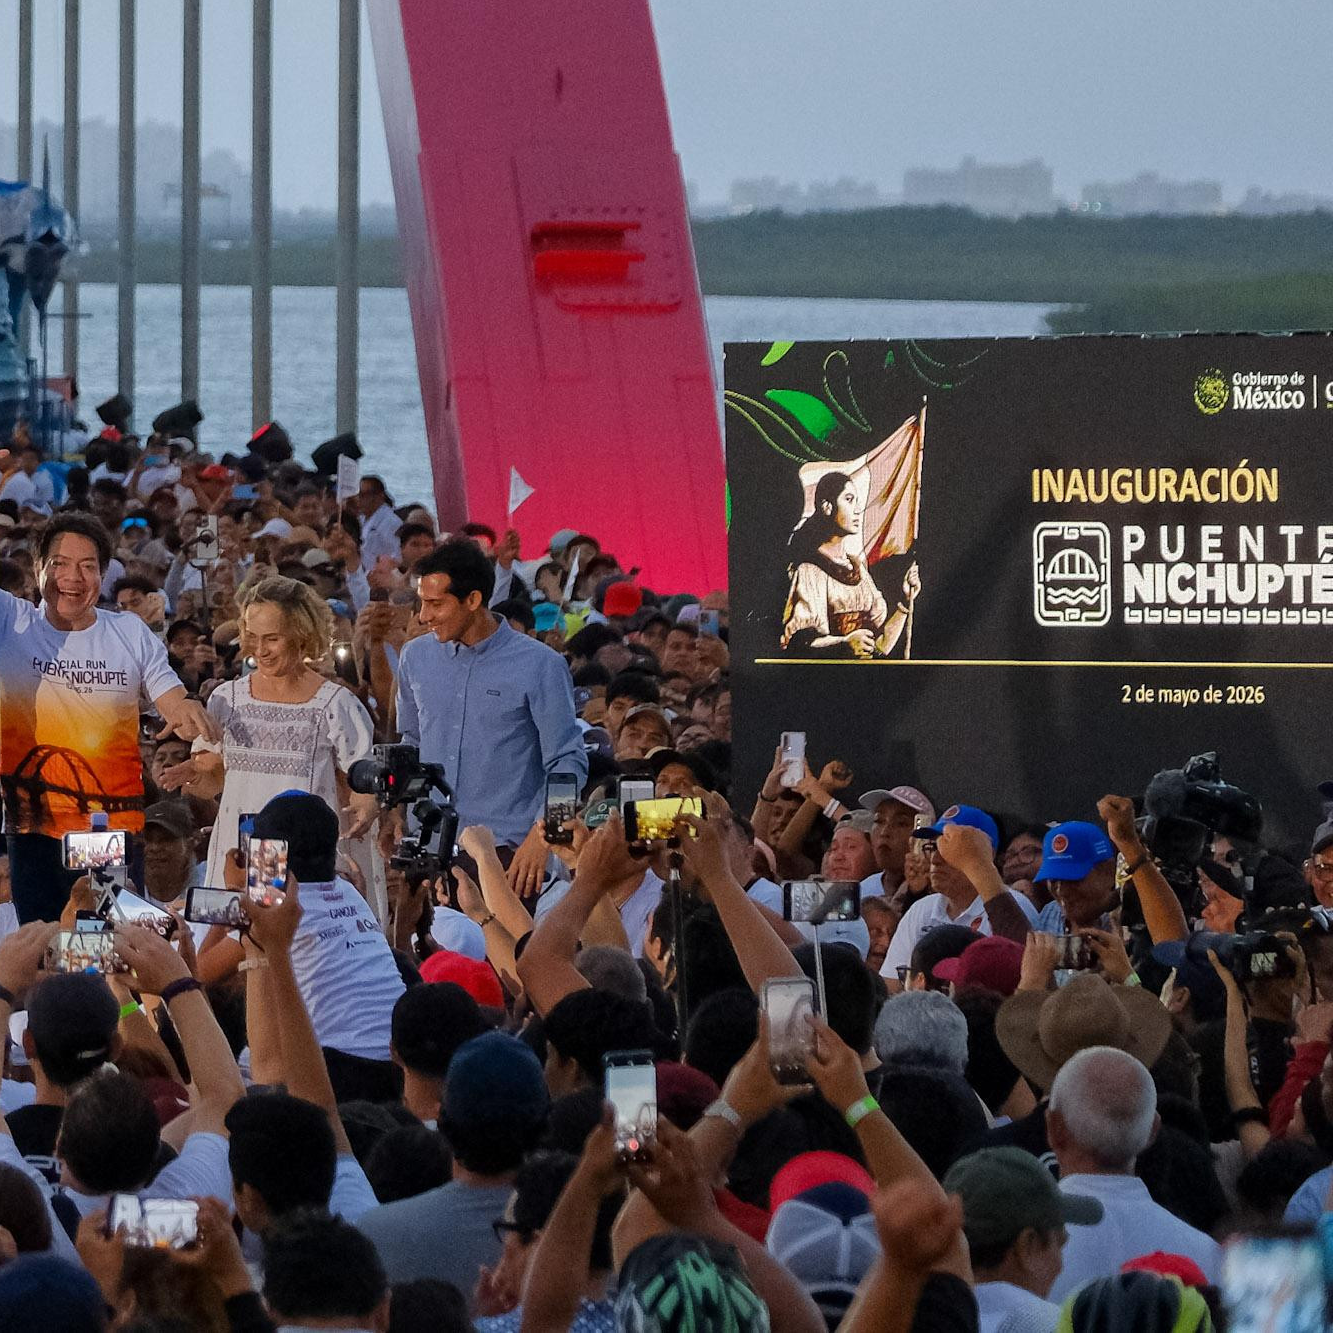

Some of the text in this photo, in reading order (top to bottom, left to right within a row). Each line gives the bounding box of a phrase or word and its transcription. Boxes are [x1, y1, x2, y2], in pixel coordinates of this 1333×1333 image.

[1233, 371, 1306, 386] Gobierno de
[1233, 385, 1306, 409] México
[1032, 459, 1279, 503] INAUGURACIÓN
[85, 660, 107, 669] RUN
[71, 669, 128, 686] NICHUPTÉ
[1121, 684, 1265, 707] 2 de mayo de 2026
